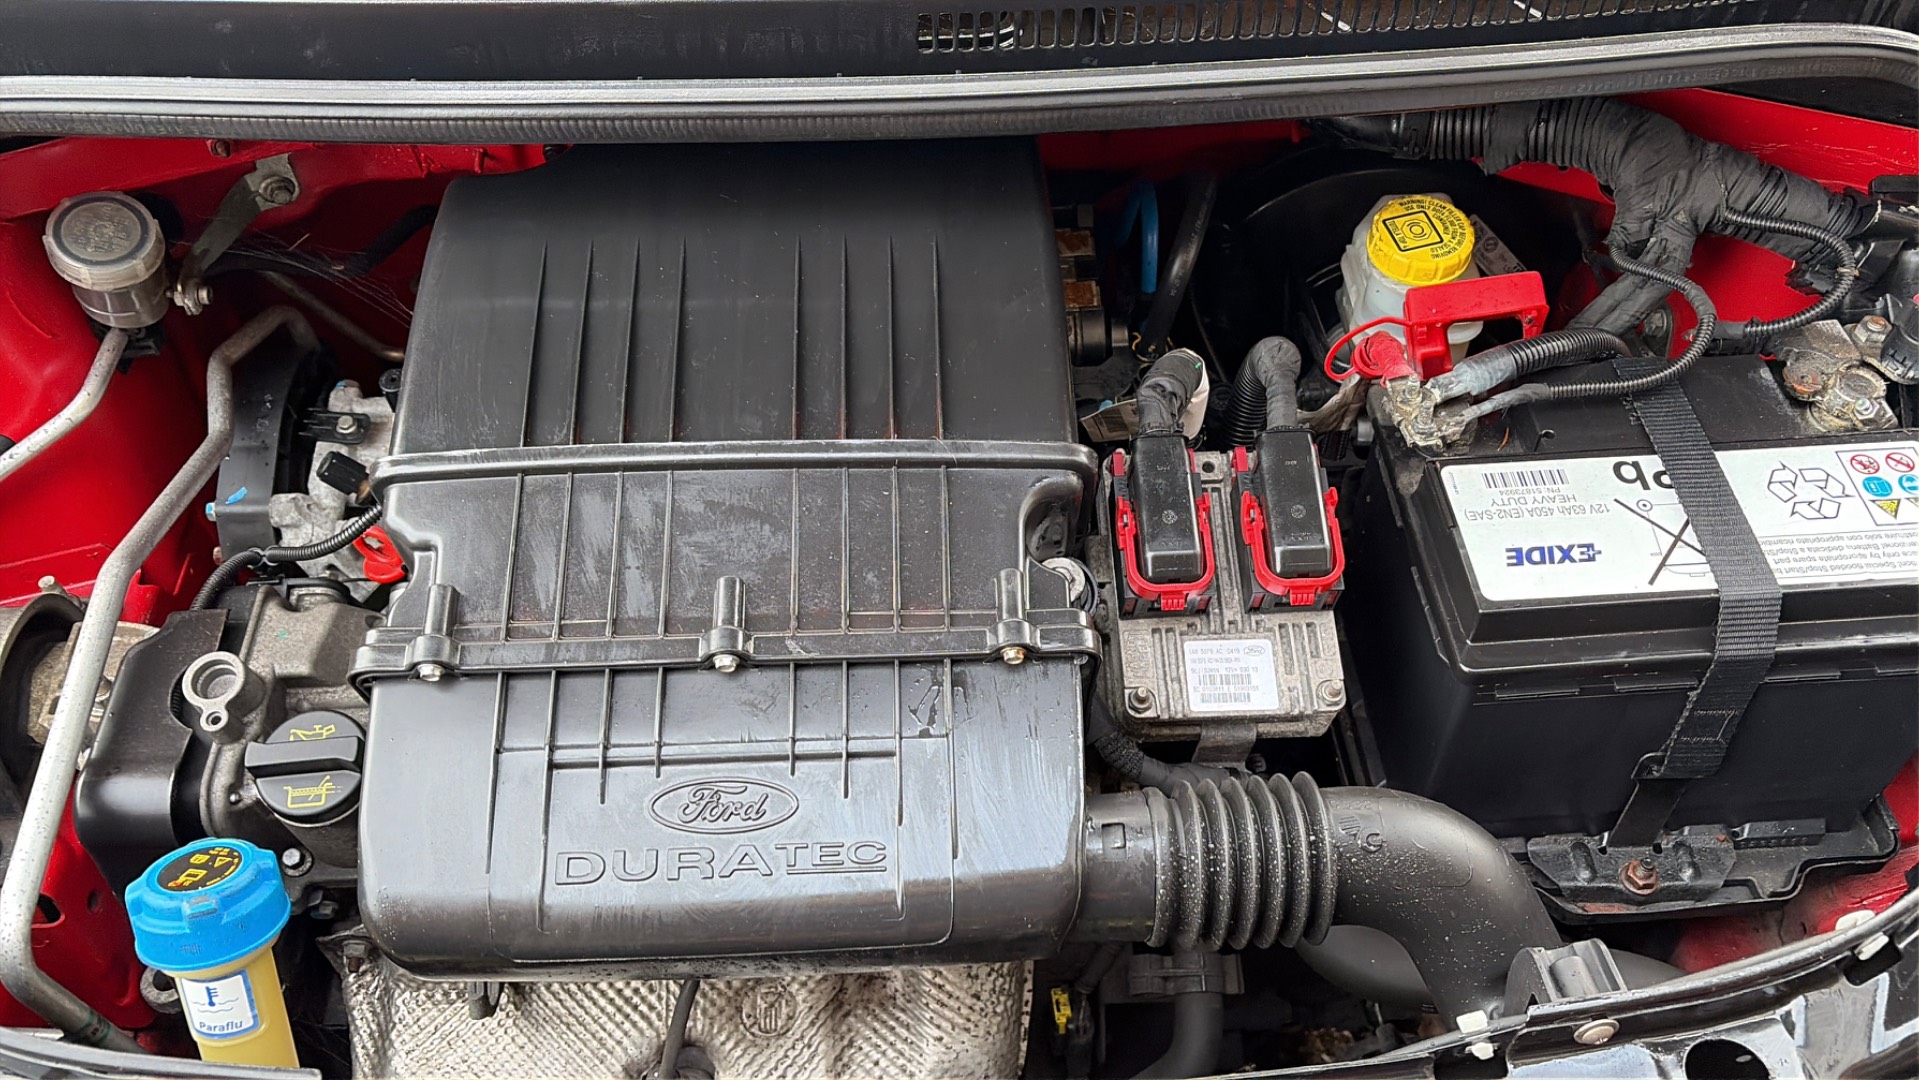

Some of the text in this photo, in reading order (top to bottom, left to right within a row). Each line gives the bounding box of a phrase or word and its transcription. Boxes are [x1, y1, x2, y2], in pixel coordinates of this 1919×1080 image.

[1428, 200, 1447, 210] CLEAN
[1446, 207, 1462, 222] FILLER
[1455, 232, 1466, 248] BEFORE
[1430, 241, 1451, 253] SEALED
[1431, 246, 1459, 259] REMOVING
[1498, 488, 1542, 496] 51873924
[1490, 494, 1577, 507] HEAVY DUTY
[1464, 504, 1610, 520] 12V 63Ah 450A (EN2-SAE)
[1796, 536, 1845, 544] appropriato
[1505, 543, 1602, 567] EXIDE
[1819, 553, 1867, 562] appropriate
[1784, 565, 1828, 574] Stop/Start
[677, 784, 767, 824] Ford
[554, 842, 887, 886] DURATEC
[199, 1020, 243, 1032] Paraflu
